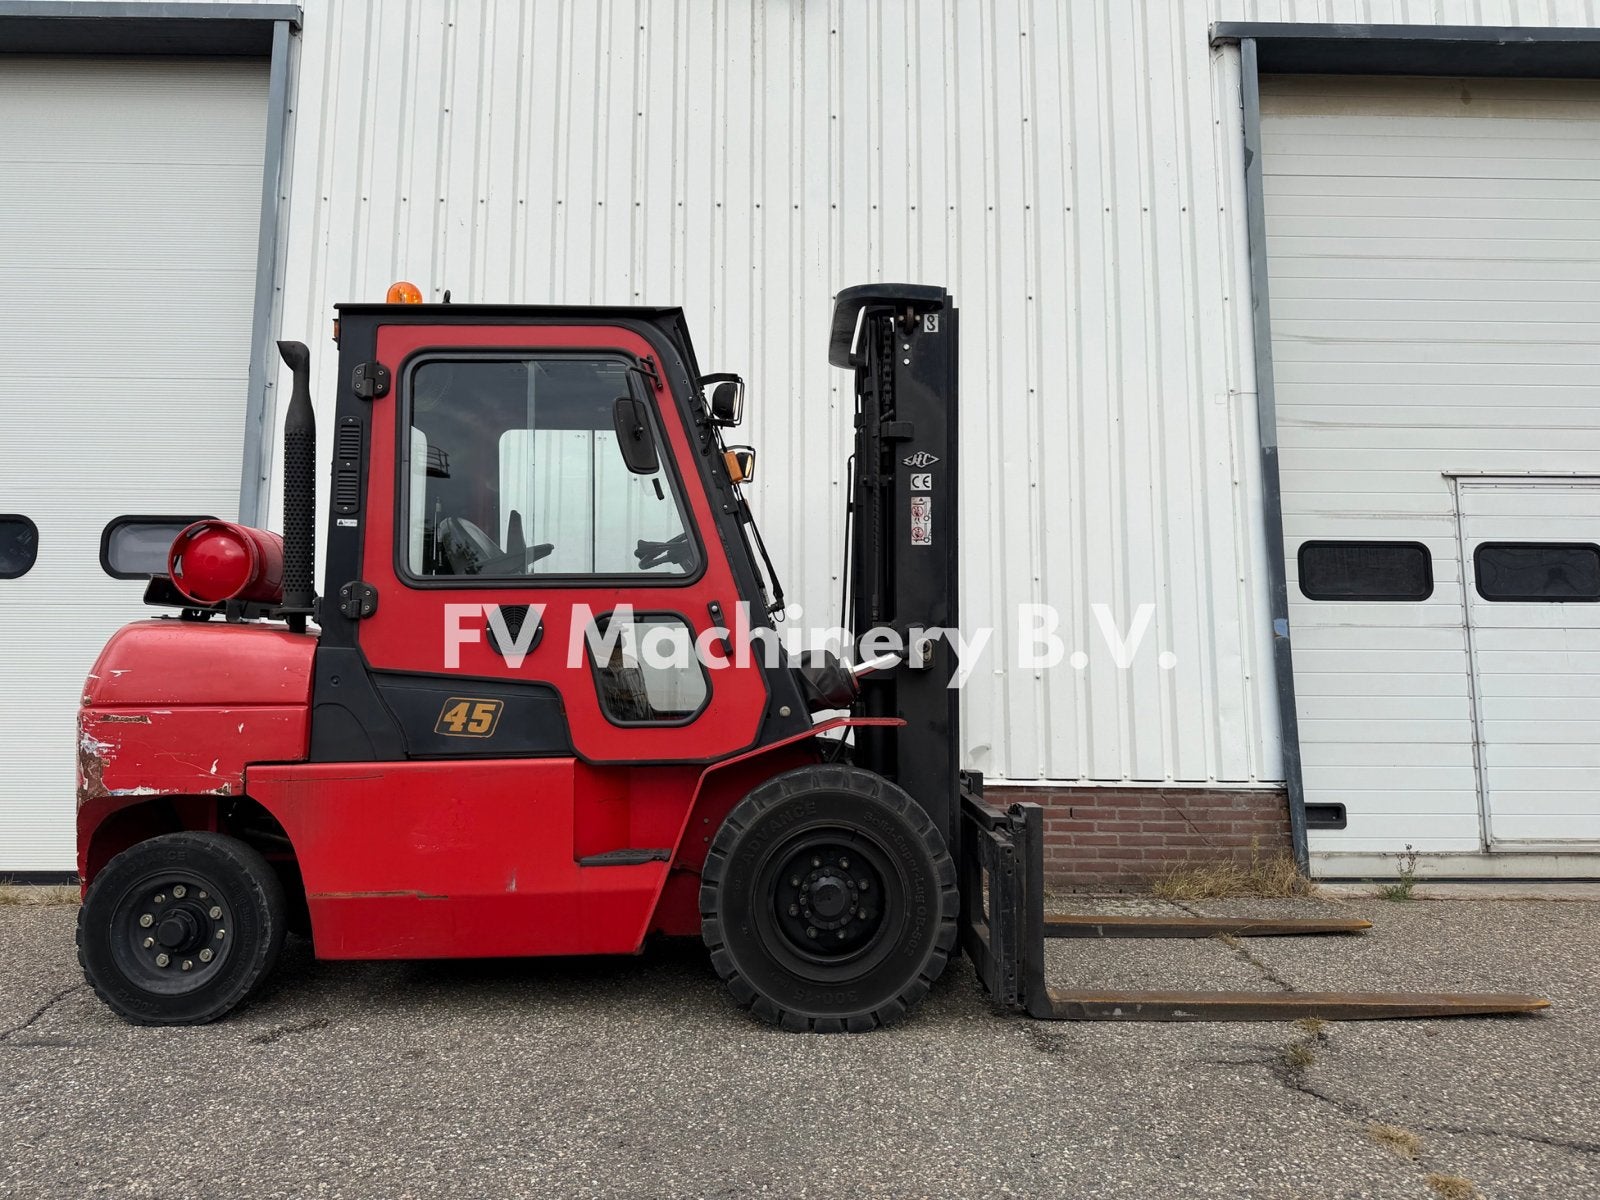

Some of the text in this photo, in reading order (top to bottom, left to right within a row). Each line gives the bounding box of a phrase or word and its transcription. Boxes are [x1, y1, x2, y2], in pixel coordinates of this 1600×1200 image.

[911, 475, 931, 489] CE
[443, 702, 496, 733] 45
[740, 800, 818, 864] ADVANCE
